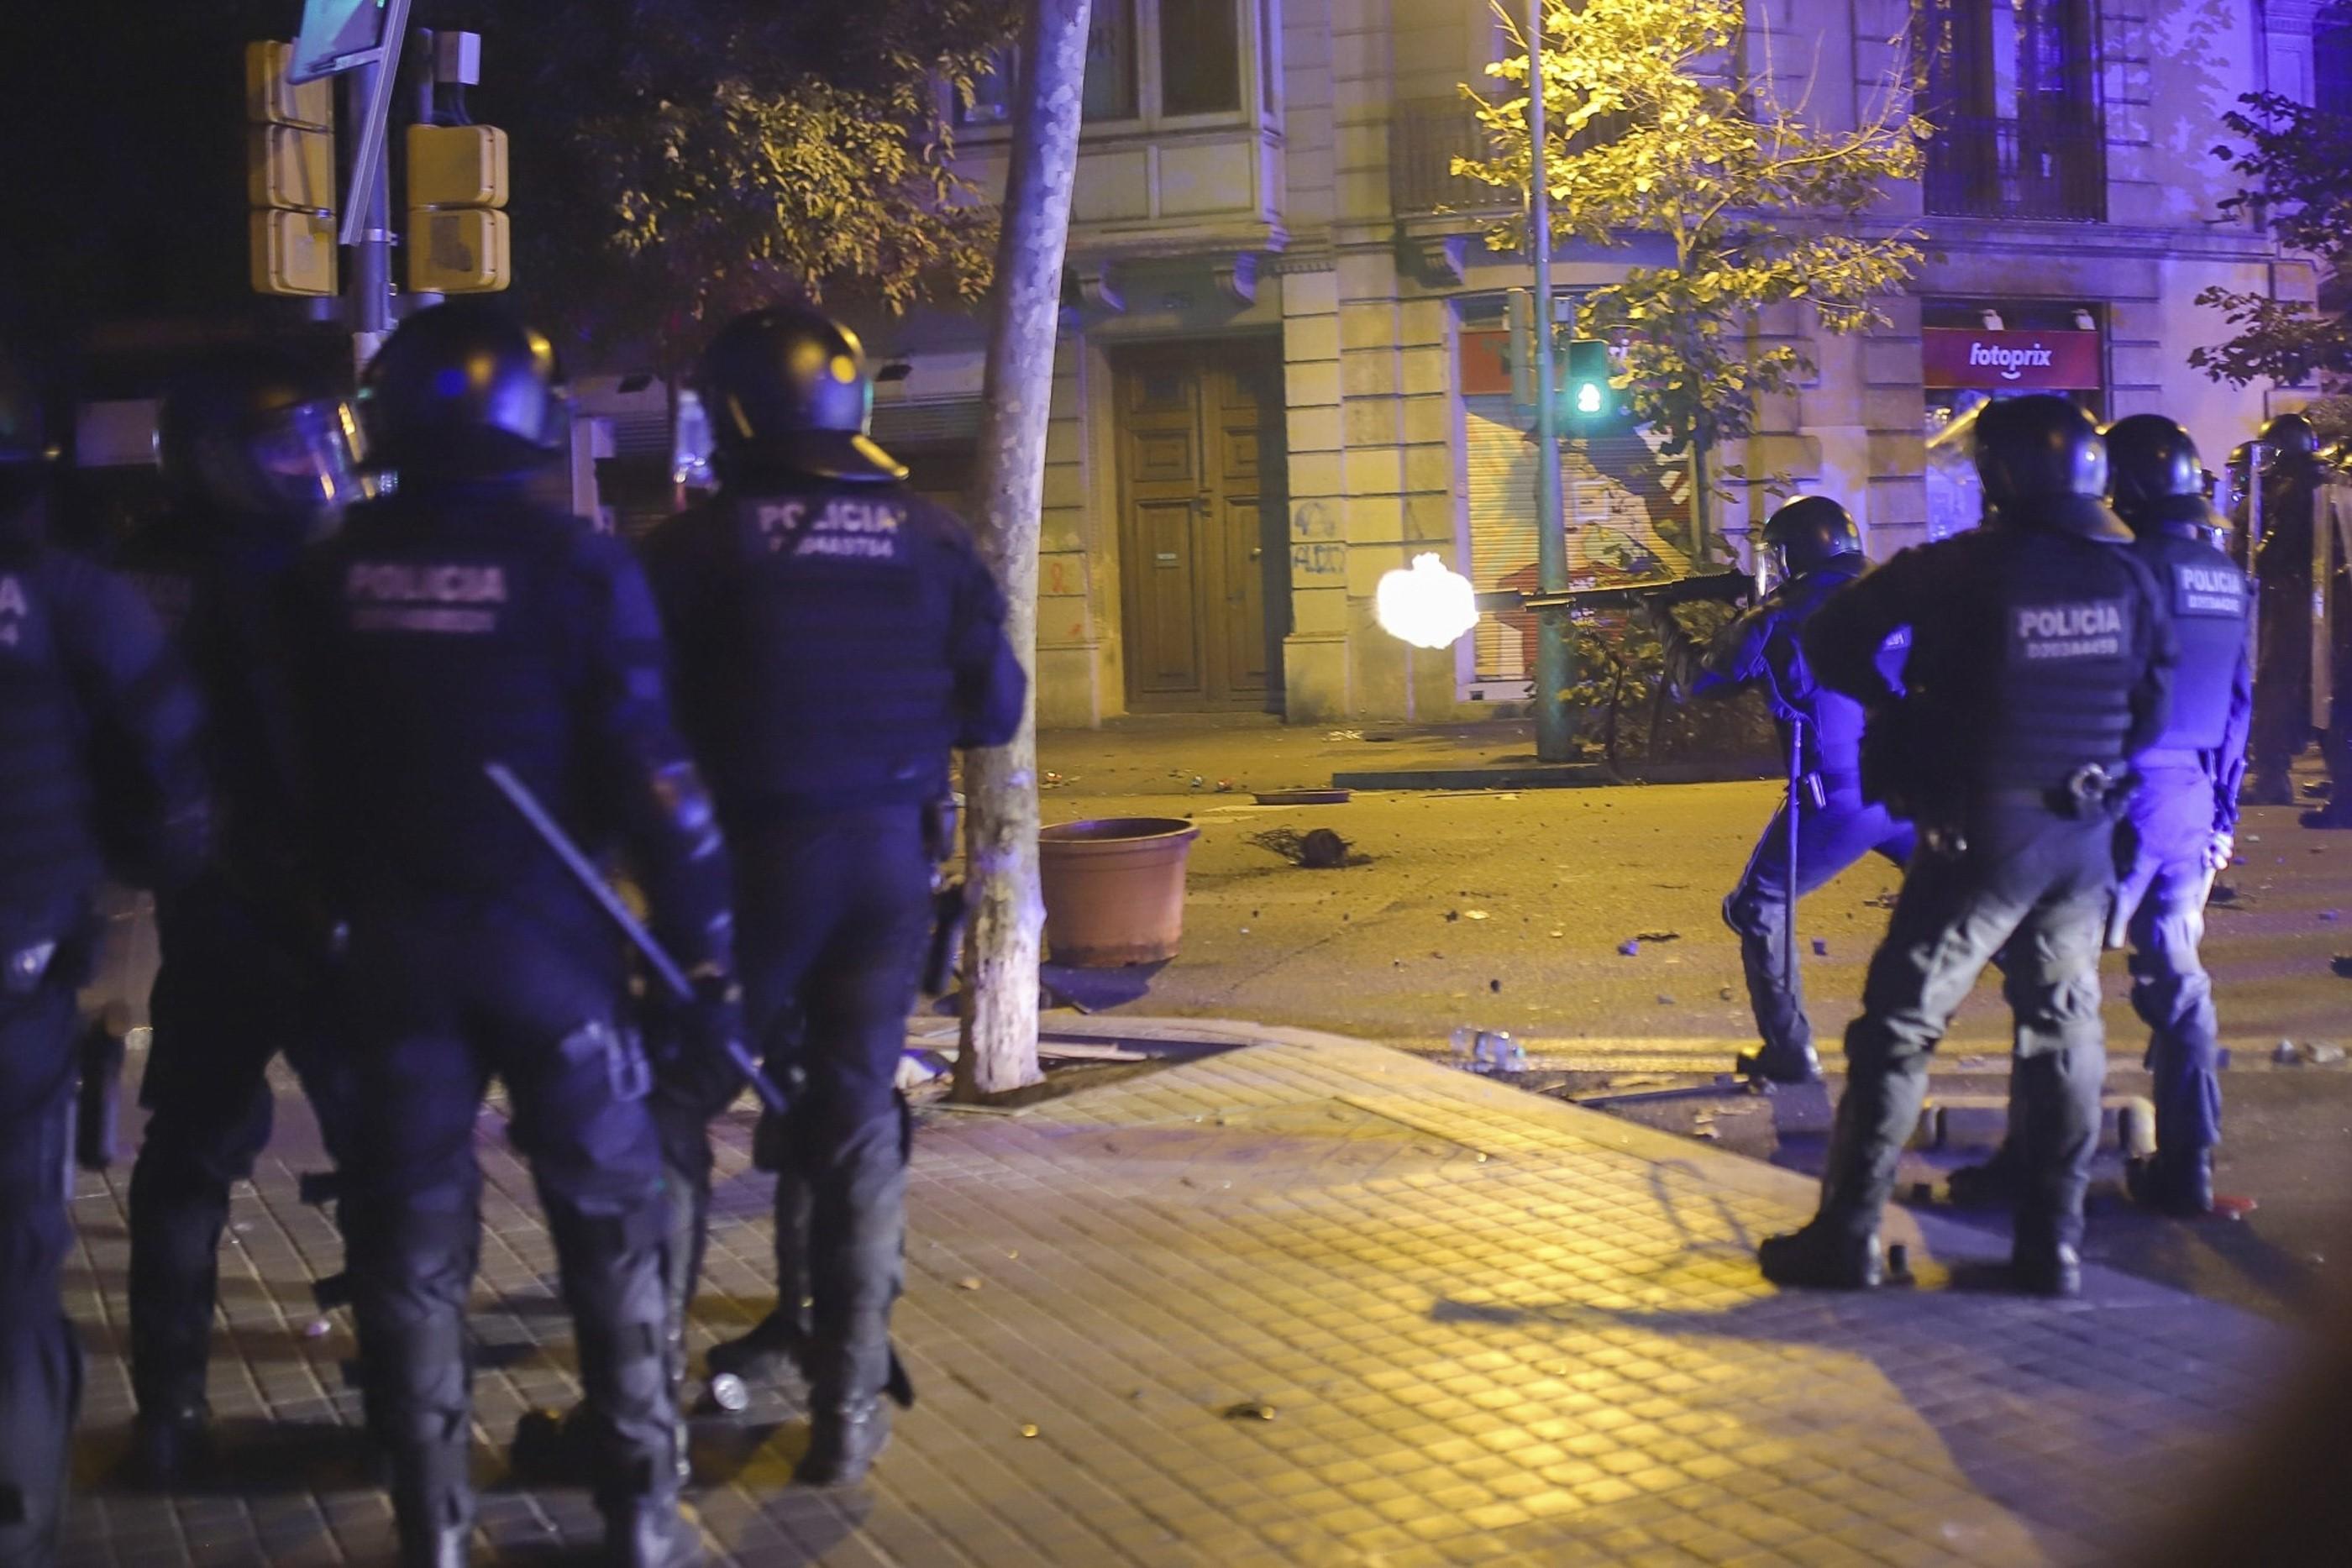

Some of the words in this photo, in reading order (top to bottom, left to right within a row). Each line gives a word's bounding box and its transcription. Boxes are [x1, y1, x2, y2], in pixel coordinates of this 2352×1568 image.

[1969, 343, 2051, 371] fotoprix
[758, 501, 898, 533] POICIA
[2181, 569, 2241, 595] POLICIA
[2018, 606, 2122, 637] POLICIA
